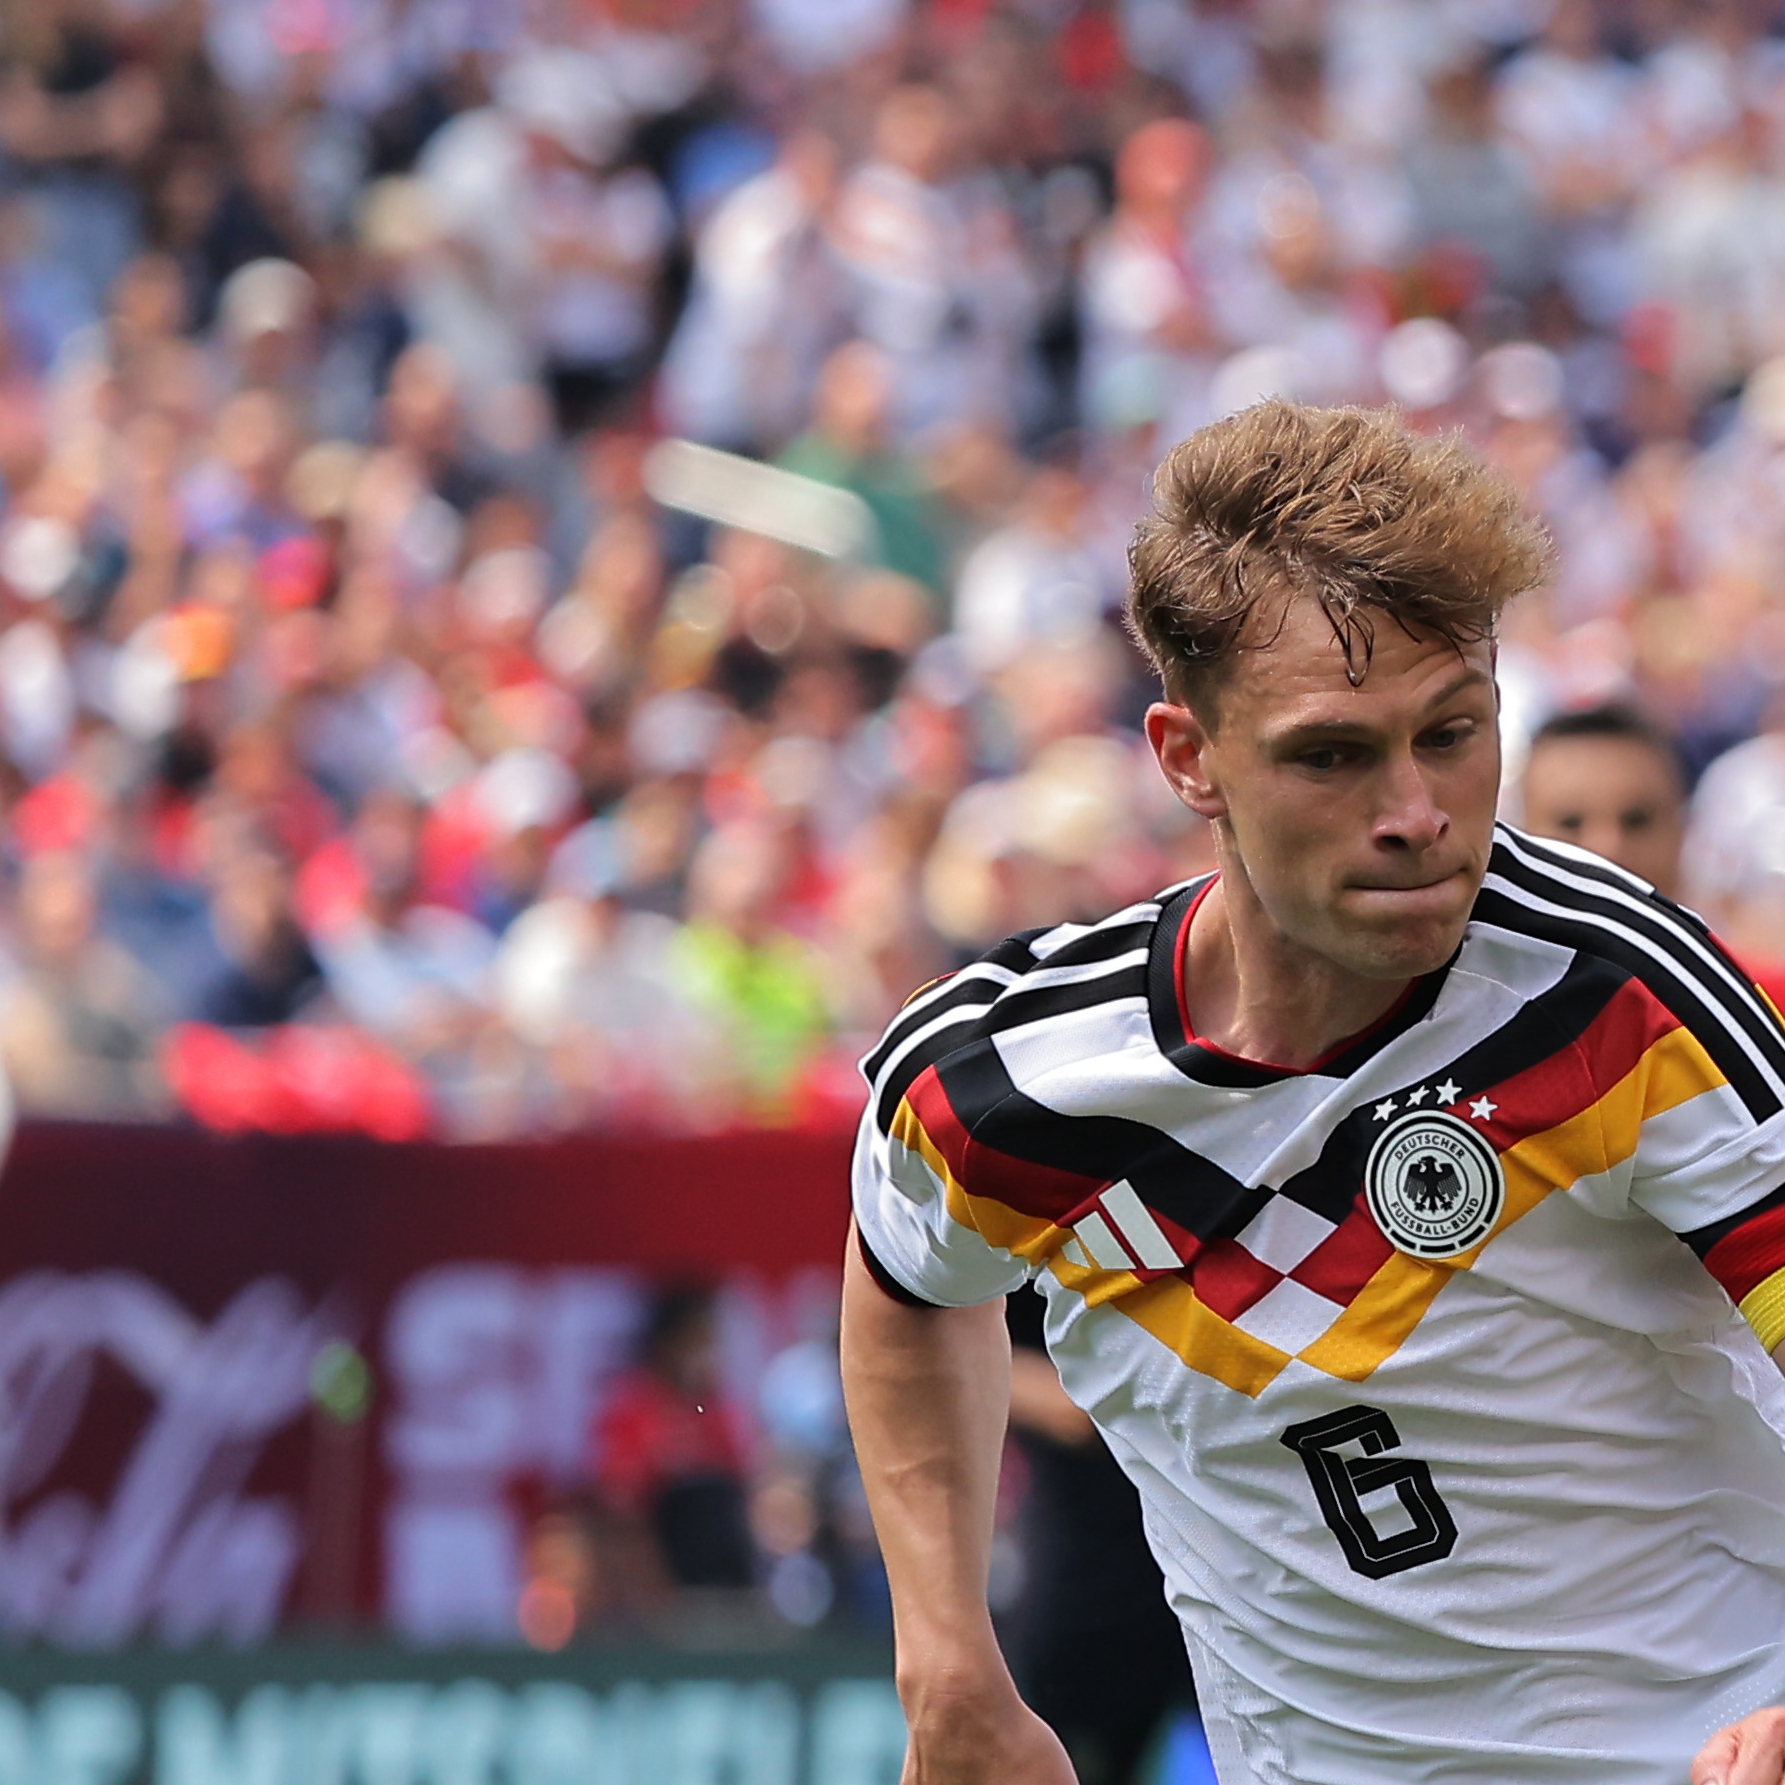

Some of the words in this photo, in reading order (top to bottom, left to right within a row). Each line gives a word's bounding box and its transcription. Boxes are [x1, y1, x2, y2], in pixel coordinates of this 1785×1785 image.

[1394, 1134, 1465, 1161] DEUTSCHER
[1391, 1197, 1479, 1235] FUSSBALL-BUND
[1281, 1405, 1458, 1581] 6
